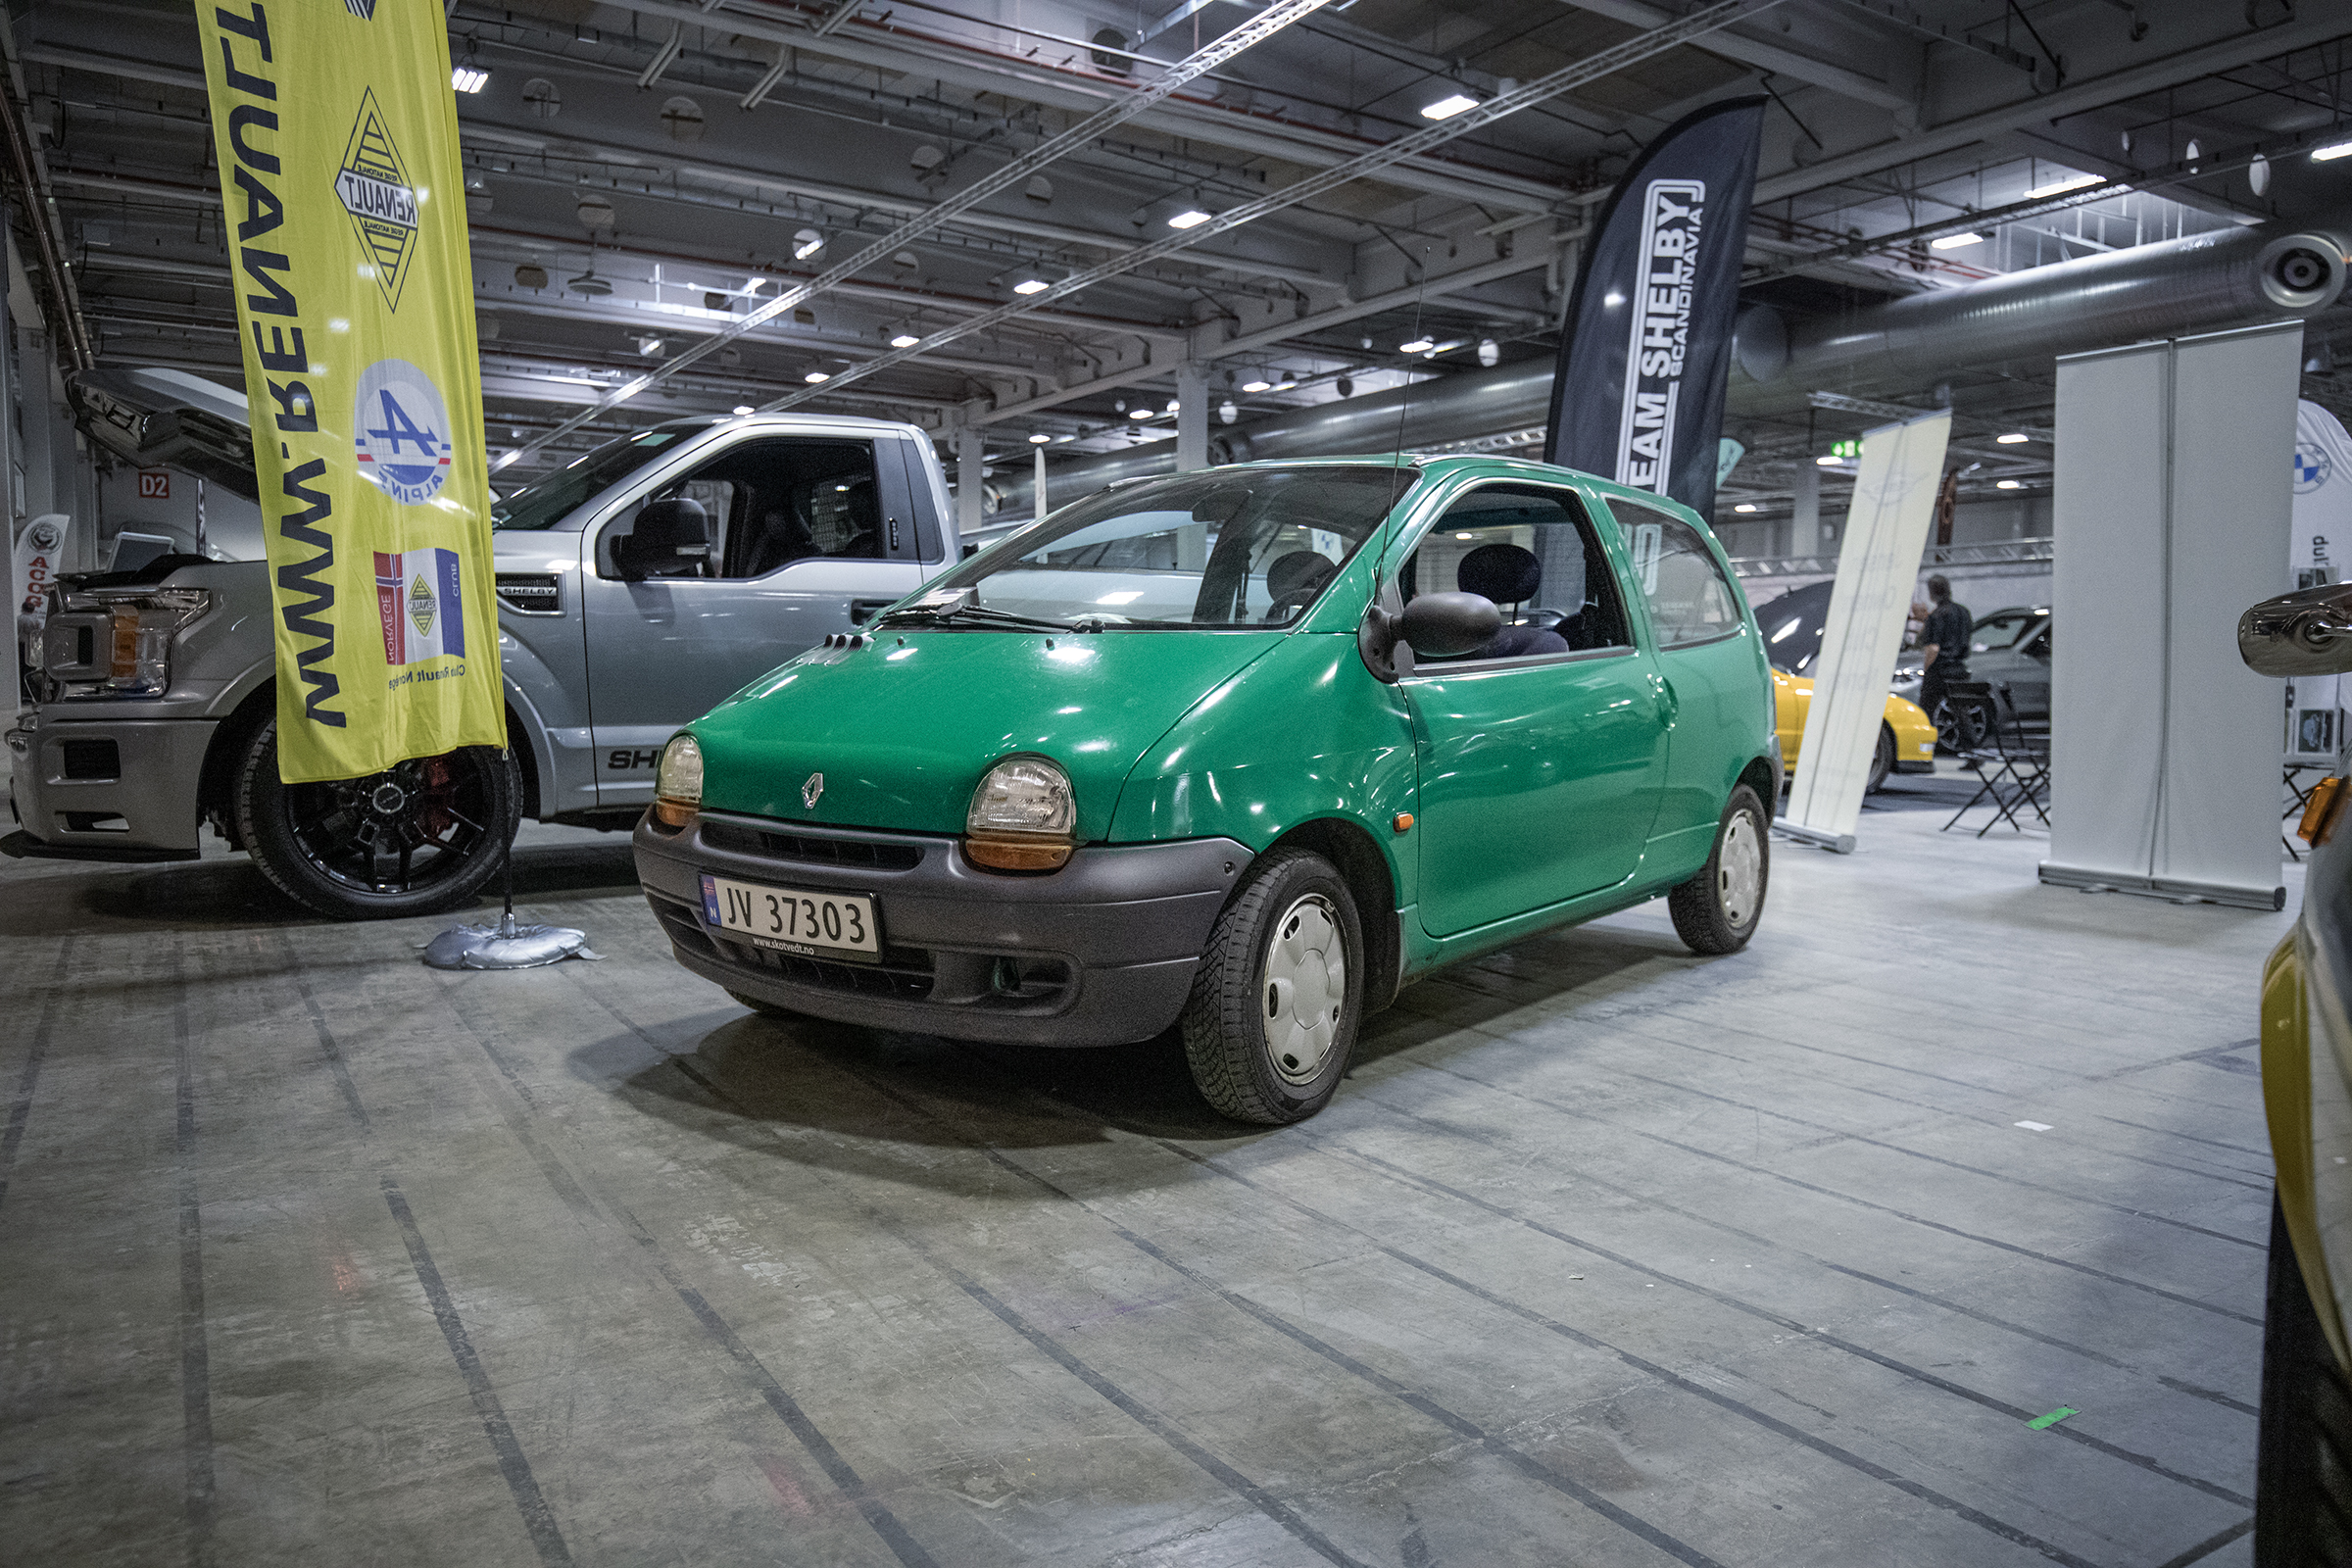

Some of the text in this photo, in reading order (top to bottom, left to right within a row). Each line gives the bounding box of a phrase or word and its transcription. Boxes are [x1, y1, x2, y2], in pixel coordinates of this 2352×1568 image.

[1670, 207, 1703, 376] SCANDINAVIA
[1629, 194, 1690, 486] EAM SHELBY
[141, 474, 168, 497] D2
[608, 750, 662, 769] SH
[710, 906, 717, 918] N
[726, 887, 865, 944] JV 37303
[753, 937, 814, 956] www.skotvedt.no
